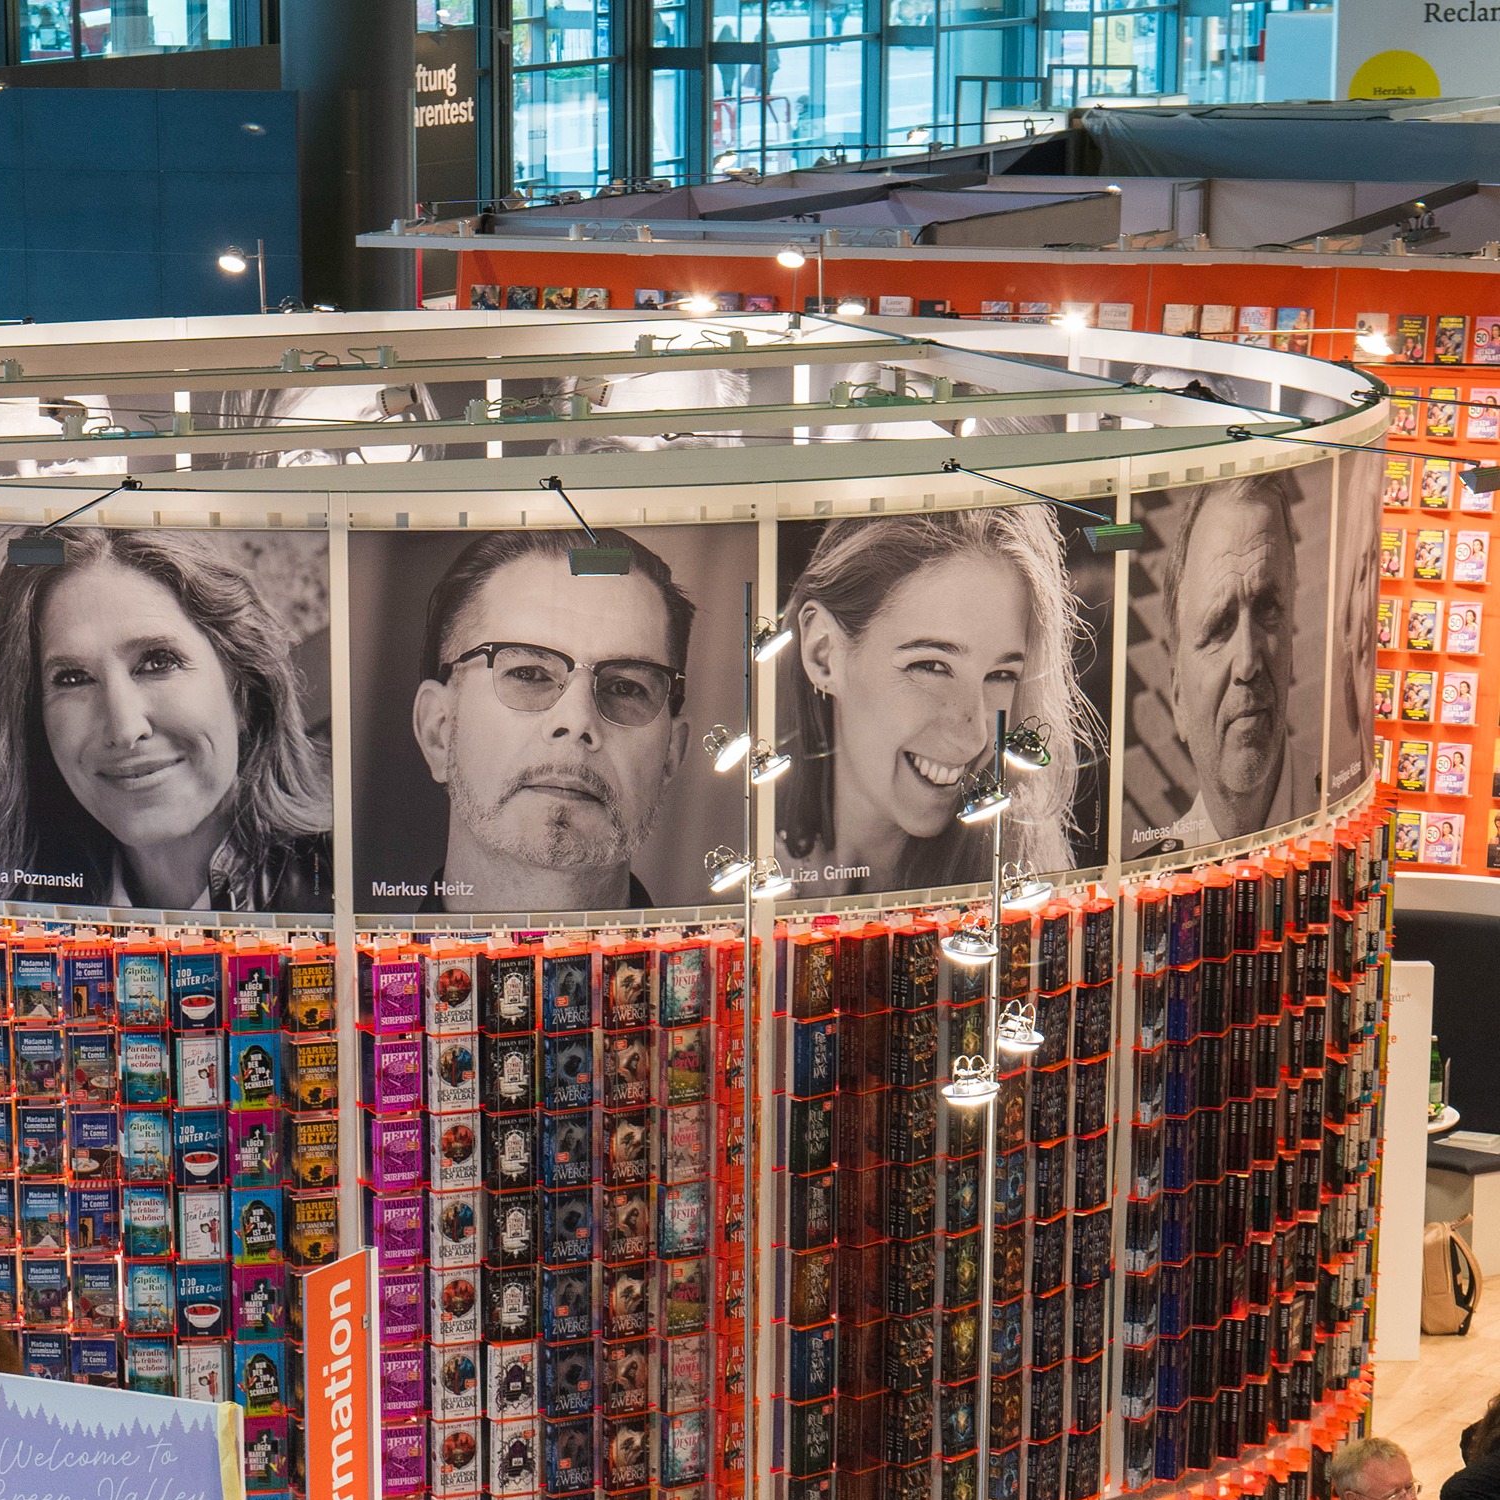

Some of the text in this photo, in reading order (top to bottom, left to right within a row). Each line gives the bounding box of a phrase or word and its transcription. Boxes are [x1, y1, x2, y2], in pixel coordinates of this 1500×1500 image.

[1373, 86, 1416, 96] Herzlich
[1476, 332, 1488, 343] 50
[1457, 547, 1468, 557] 50
[1450, 618, 1461, 628] 50
[1444, 689, 1455, 699] 50
[1438, 760, 1449, 770] 50
[1131, 818, 1207, 844] Andreas Kästner
[13, 868, 84, 888] Poznanski
[790, 864, 870, 882] Liza Grimm
[371, 880, 474, 897] Markus Heitz
[75, 961, 103, 969] Monsieur
[83, 968, 103, 976] Comte
[125, 967, 152, 976] Gipfel
[176, 968, 192, 979] TOD
[175, 976, 201, 988] UNTER
[292, 974, 333, 988] HEITZ
[380, 972, 417, 987] HEITZ
[245, 981, 263, 991] LÜGEN
[239, 990, 258, 998] HABEN
[147, 1438, 178, 1473] to
